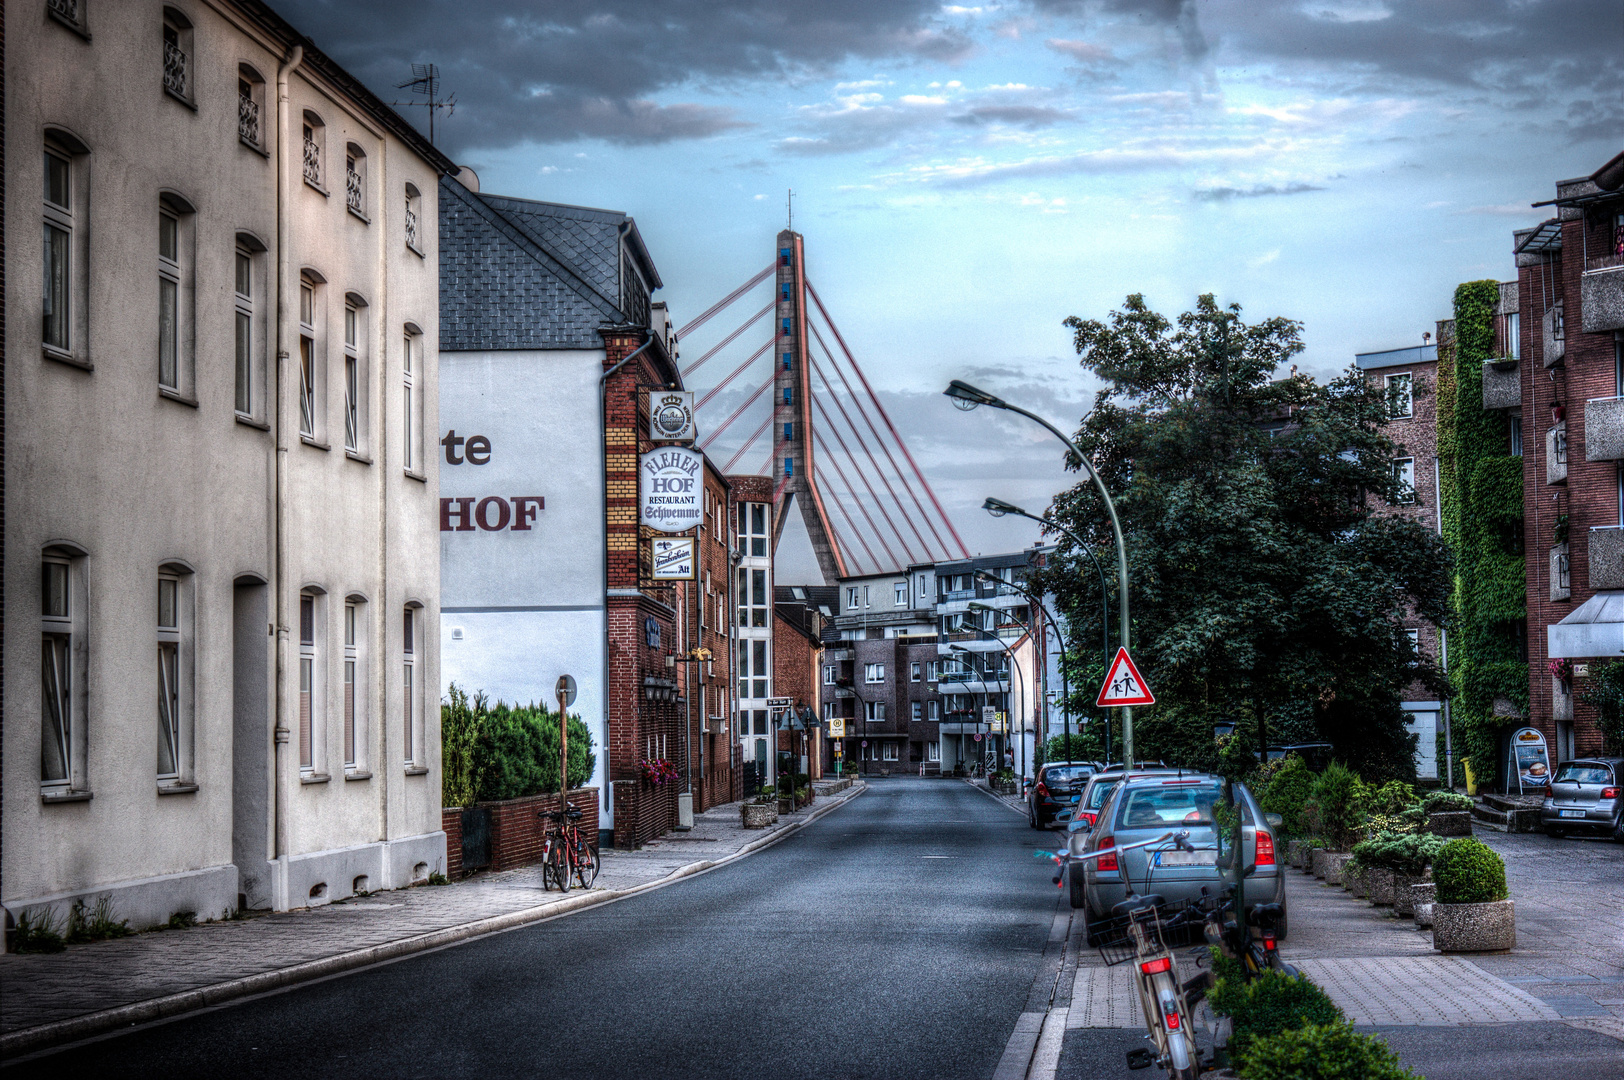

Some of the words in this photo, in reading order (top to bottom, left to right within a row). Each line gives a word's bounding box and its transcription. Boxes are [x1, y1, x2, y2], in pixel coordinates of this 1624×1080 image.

[653, 405, 661, 416] EINE
[682, 405, 692, 424] BIEREN
[653, 417, 665, 436] KÖNIGIN
[681, 424, 690, 434] DEN
[439, 429, 492, 466] te
[644, 452, 700, 477] FLEHER
[651, 477, 695, 493] HOF
[649, 496, 696, 505] RESTAURANT
[439, 496, 545, 532] HOF
[644, 506, 700, 522] Schwemme
[678, 564, 690, 575] Alt
